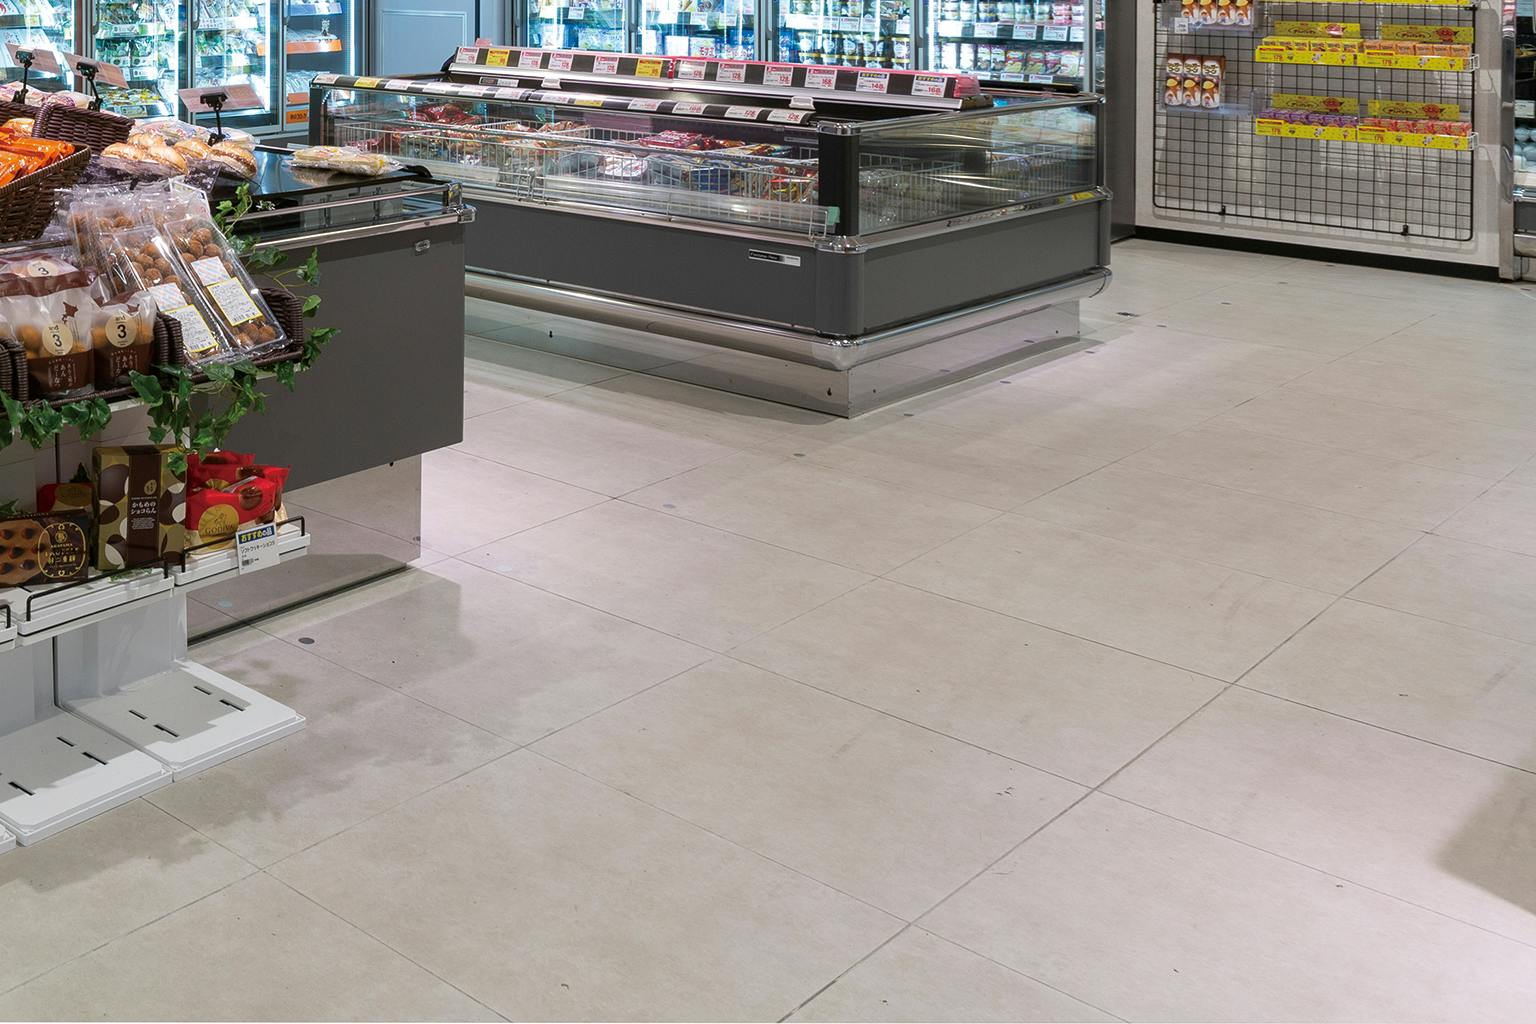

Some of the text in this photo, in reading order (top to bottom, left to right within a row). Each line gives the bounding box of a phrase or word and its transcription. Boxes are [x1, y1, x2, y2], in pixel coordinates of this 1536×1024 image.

[38, 267, 50, 276] 3
[117, 324, 127, 339] 3
[52, 333, 63, 347] 3
[130, 508, 157, 516] ショコらん
[205, 523, 234, 534] GODIVA
[241, 527, 272, 542] おすすめの品
